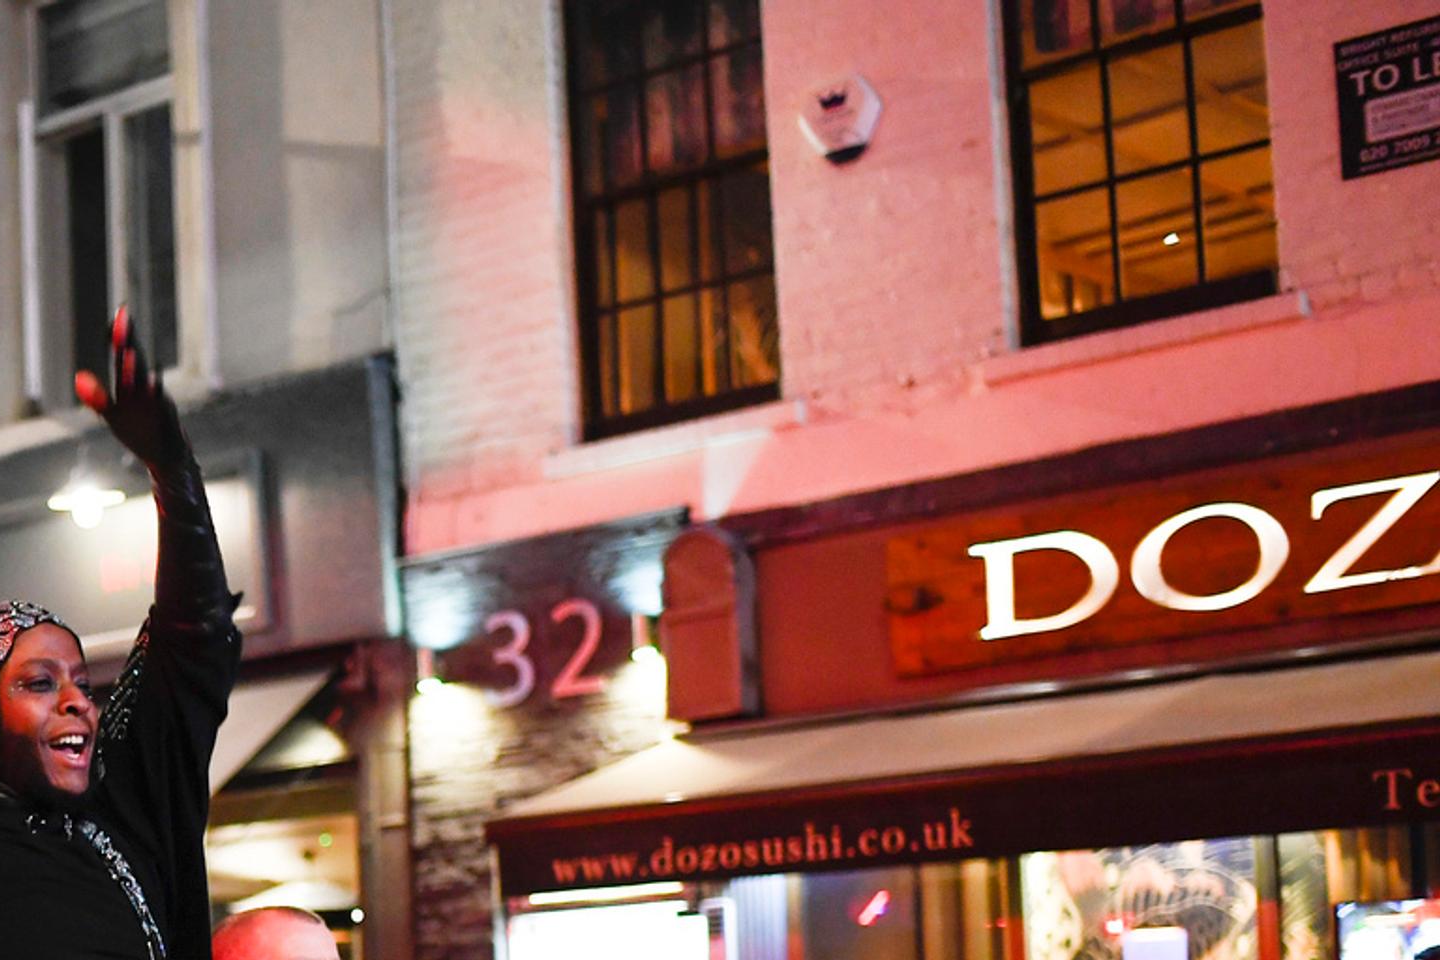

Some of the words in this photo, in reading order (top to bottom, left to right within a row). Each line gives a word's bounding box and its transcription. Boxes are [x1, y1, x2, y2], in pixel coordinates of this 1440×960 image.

[1349, 63, 1401, 96] TO
[968, 471, 1440, 641] DOZ
[483, 598, 605, 708] 32
[1371, 767, 1440, 809] Te
[552, 807, 975, 884] www.dozosushi.co.uk
